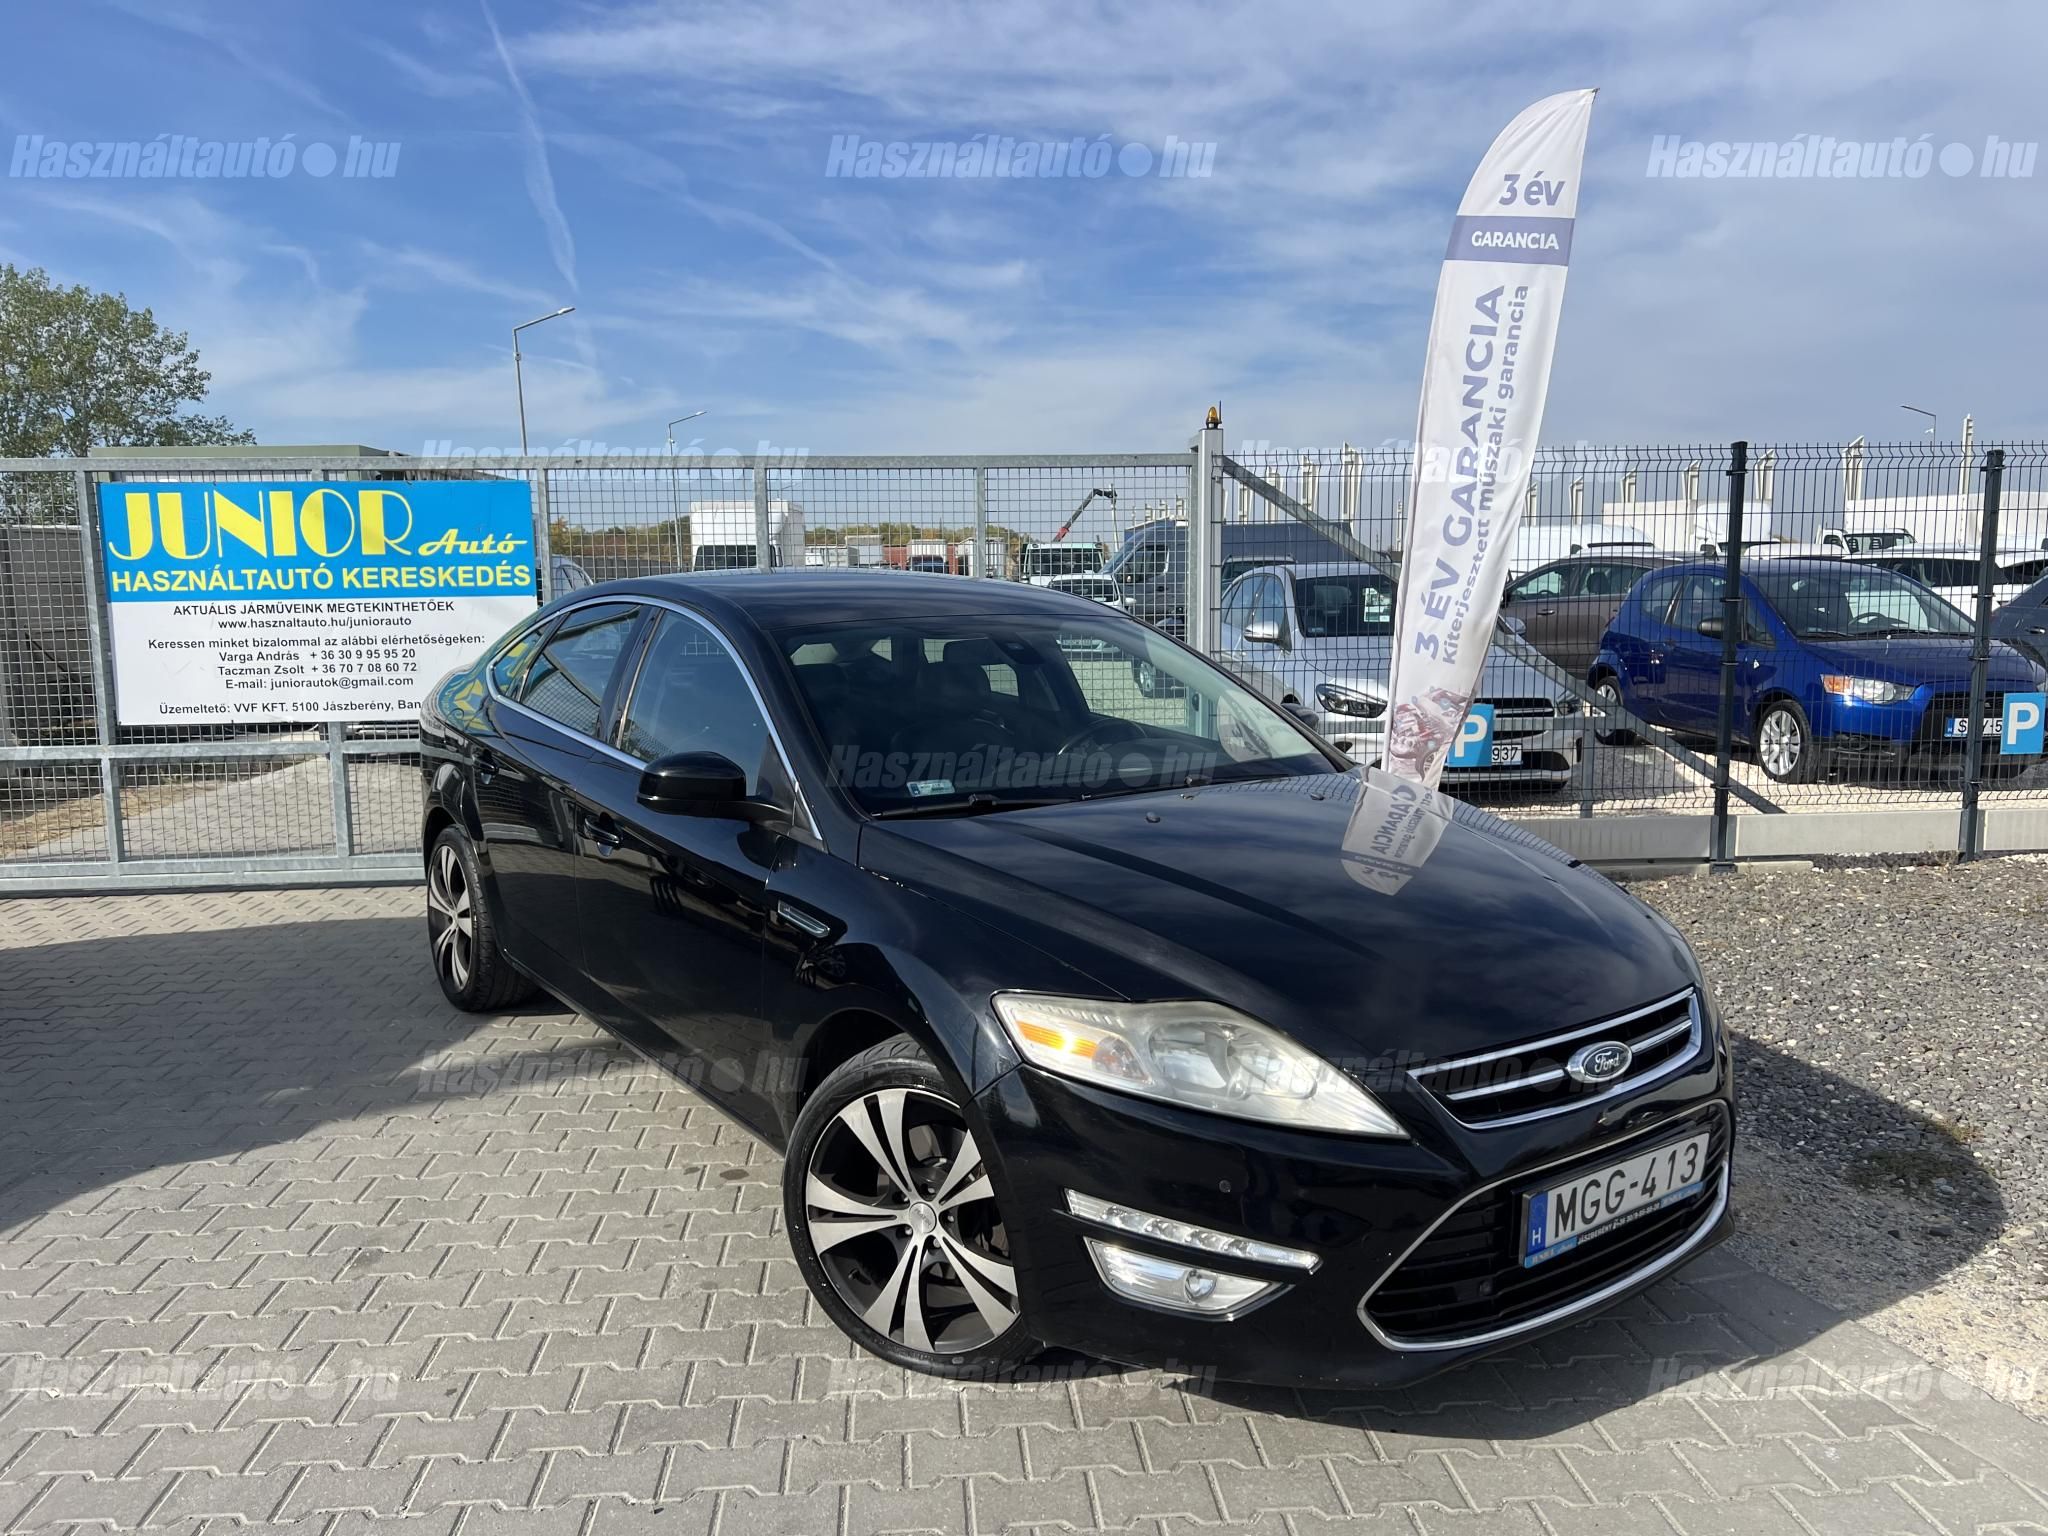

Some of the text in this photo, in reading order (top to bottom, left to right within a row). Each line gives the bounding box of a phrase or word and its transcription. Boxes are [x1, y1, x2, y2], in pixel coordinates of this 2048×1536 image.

[1499, 171, 1566, 206] 3 év
[1471, 231, 1559, 249] GARANCIA
[1414, 285, 1504, 660] 3 ÉV GARANCIA
[1442, 518, 1491, 664] Kiterjesztett
[1498, 285, 1529, 399] garancia
[108, 489, 528, 560] JUNIOR Autó
[112, 560, 531, 592] HASZNÁLTAUTÓ KERESKEDÉS
[173, 600, 454, 615] AKTUÁLIS JÁRMŰVEINK MEGTEKINTHETŐEK
[218, 616, 412, 629] www.hasznaltauto.hu/juniorauto
[148, 639, 205, 649] Keressen
[208, 638, 249, 648] minket
[252, 637, 321, 648] bizalommal
[341, 635, 378, 646] alábbi
[381, 634, 485, 646] elérhetőségeken:
[219, 652, 253, 663] Varga
[256, 651, 300, 661] András
[321, 650, 335, 660] 36
[338, 650, 352, 660] 30
[355, 650, 363, 659] 9
[366, 649, 381, 659] 95
[384, 649, 398, 659] 95
[401, 649, 416, 658] 20
[217, 666, 270, 676] Taczman
[274, 665, 304, 675] Zsolt
[322, 664, 336, 674] 36
[339, 664, 353, 673] 70
[357, 664, 364, 673] 7
[404, 663, 417, 672] 72
[225, 676, 414, 690] E-mail: juniorautok@gmail.com
[233, 703, 258, 713] VVF
[262, 702, 289, 712] KFT.
[292, 702, 319, 711] 5100
[322, 700, 394, 712] Jászberény,
[2007, 702, 2040, 745] P
[1454, 714, 1488, 757] P
[1594, 1050, 1620, 1073] Ford
[1532, 1227, 1542, 1246] H
[1554, 1142, 1699, 1239] MGG-413
